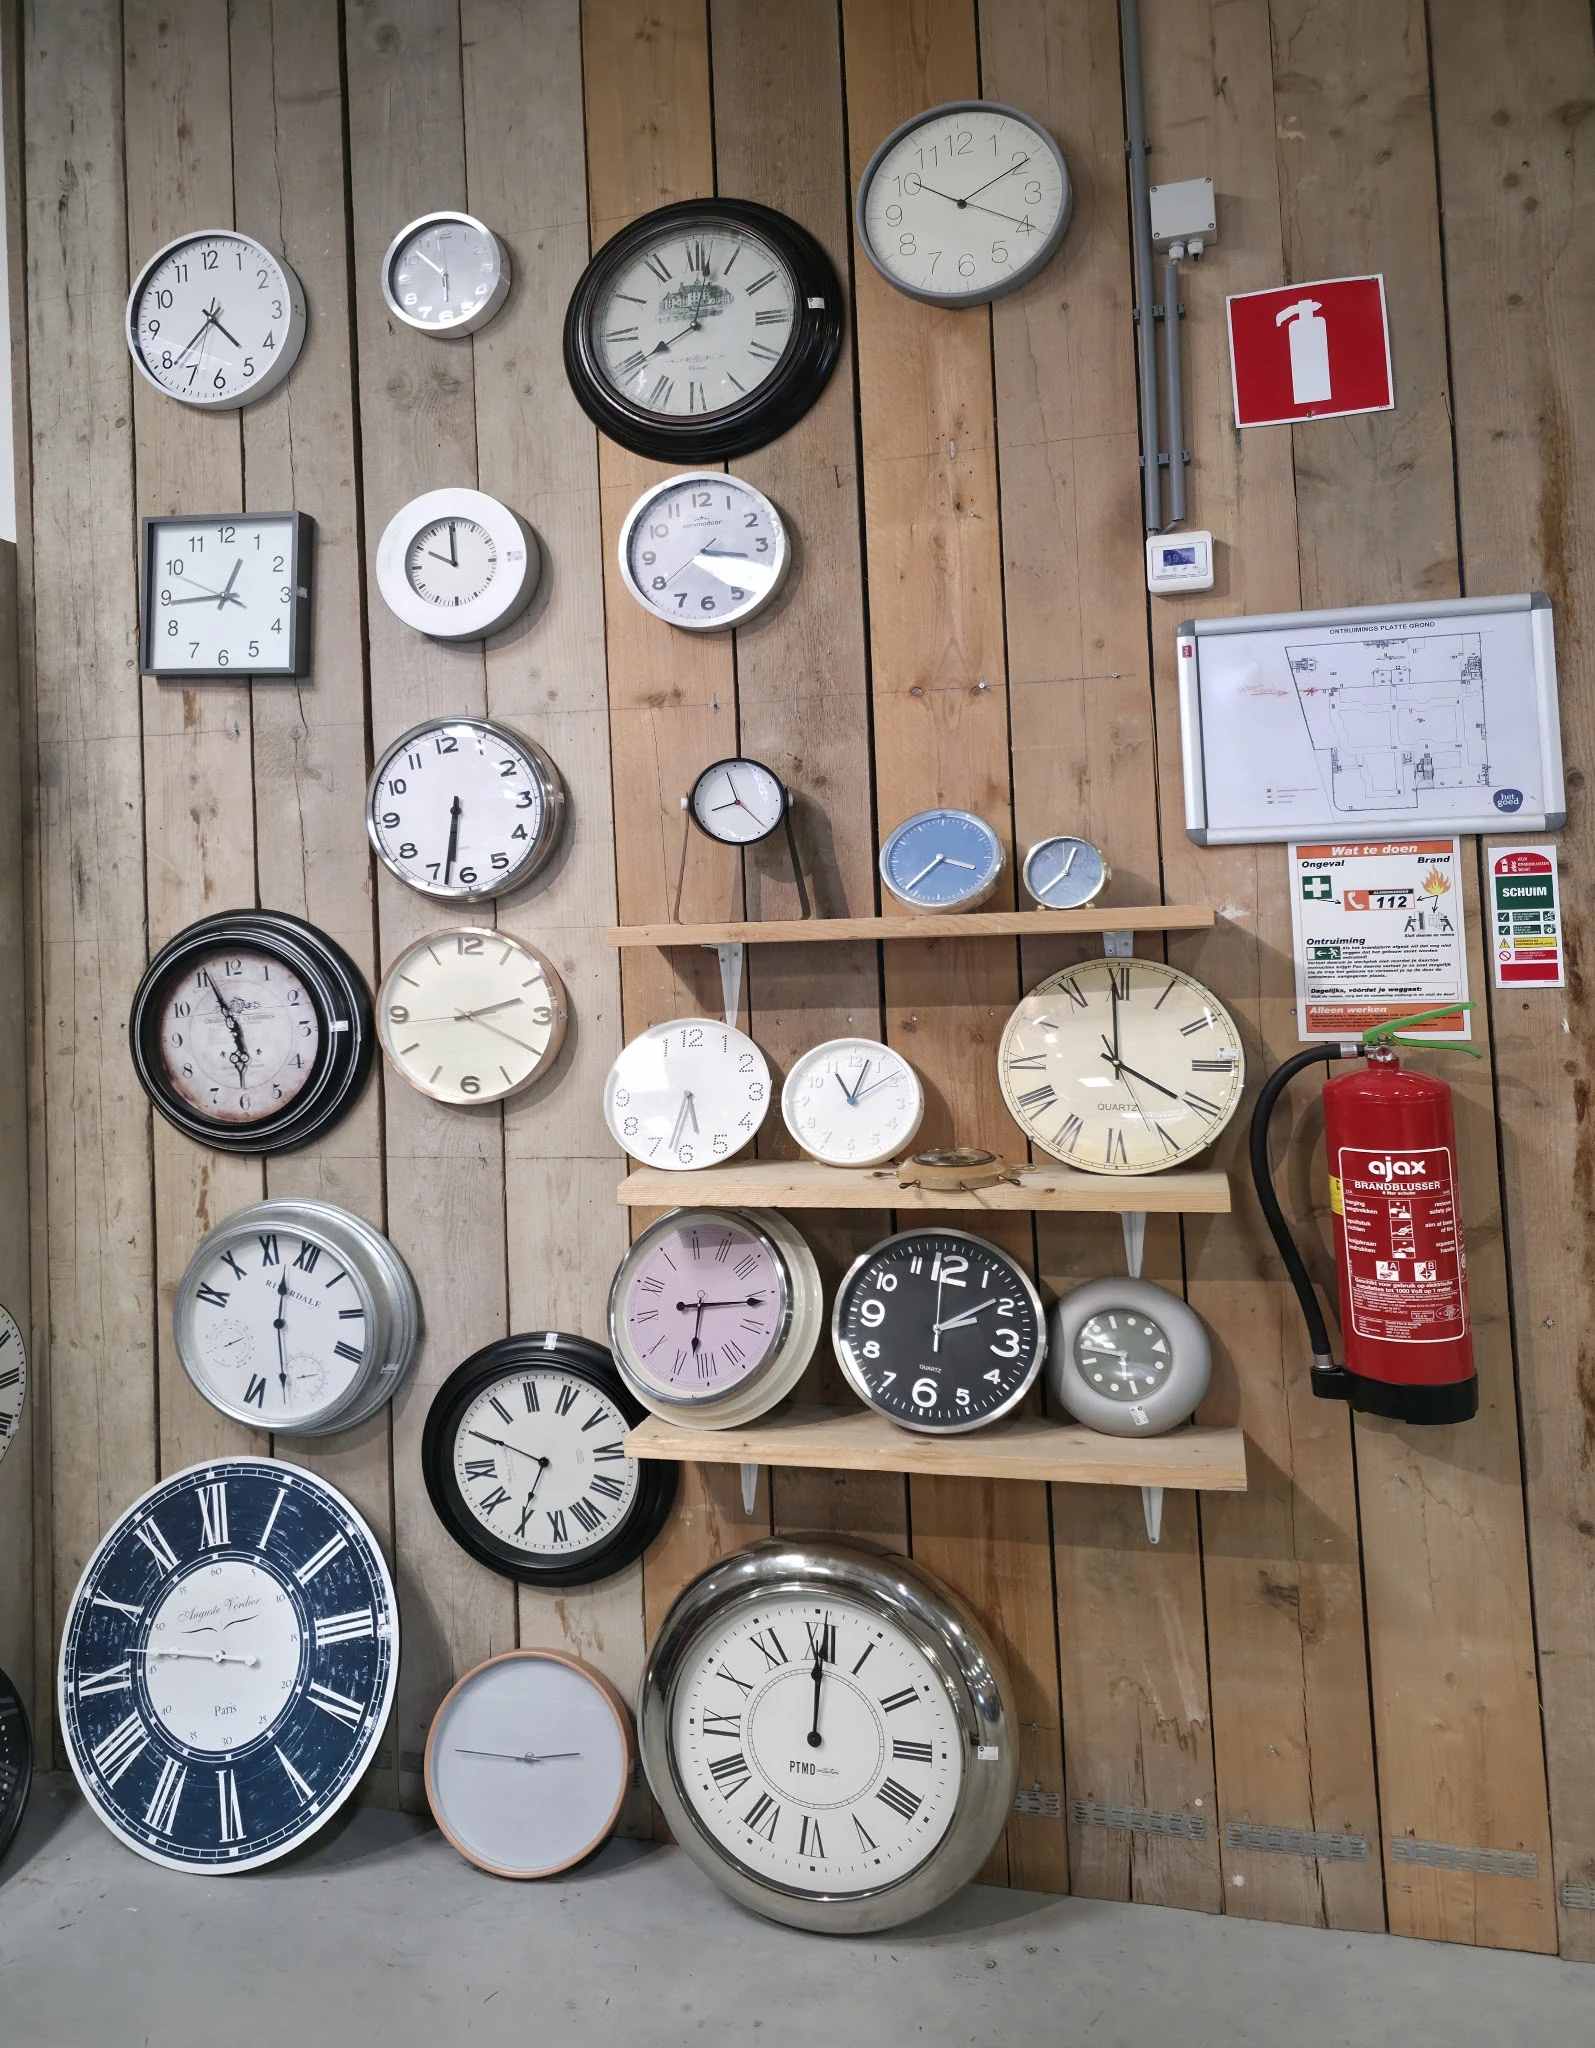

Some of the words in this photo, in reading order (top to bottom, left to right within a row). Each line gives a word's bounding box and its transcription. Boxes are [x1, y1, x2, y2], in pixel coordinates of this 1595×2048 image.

[944, 132, 973, 156] 12
[989, 135, 996, 156] 1
[915, 146, 938, 169] 11
[1012, 152, 1028, 175] 2
[893, 173, 921, 197] 10
[1025, 181, 1041, 204] 3
[886, 205, 902, 227] 9
[1016, 215, 1034, 236] 4
[900, 233, 916, 255] 8
[992, 241, 1008, 263] 5
[201, 251, 218, 270] 12
[236, 253, 242, 270] 1
[928, 251, 942, 274] 7
[959, 254, 975, 277] 6
[175, 264, 188, 283] 11
[257, 270, 269, 289] 2
[155, 290, 173, 309] 10
[272, 300, 282, 319] 3
[149, 320, 160, 340] 9
[263, 330, 275, 349] 4
[162, 351, 173, 369] 8
[243, 357, 254, 376] 5
[186, 364, 199, 386] 7
[214, 368, 225, 389] 6
[692, 493, 712, 508] 12
[727, 496, 731, 510] 1
[668, 503, 680, 518] 11
[744, 513, 758, 528] 2
[218, 527, 235, 543] 12
[650, 524, 669, 539] 10
[189, 536, 203, 552] 11
[254, 534, 260, 550] 1
[756, 537, 768, 552] 3
[273, 556, 283, 572] 2
[642, 552, 656, 565] 9
[166, 559, 183, 576] 10
[652, 576, 666, 590] 8
[161, 590, 171, 606] 9
[280, 587, 290, 603] 3
[674, 593, 687, 607] 7
[731, 587, 744, 600] 5
[701, 596, 715, 610] 6
[168, 620, 178, 636] 8
[271, 618, 282, 634] 4
[1330, 626, 1378, 634] ONTRUIMINGS
[189, 643, 199, 658] 7
[248, 641, 259, 657] 5
[218, 650, 229, 666] 6
[435, 737, 458, 754] 12
[409, 753, 422, 770] 11
[499, 760, 517, 777] 2
[389, 779, 406, 796] 10
[516, 791, 532, 808] 3
[1498, 798, 1519, 807] goed
[383, 813, 400, 828] 9
[511, 824, 528, 840] 4
[400, 843, 418, 859] 8
[1331, 847, 1358, 856] Wat
[1364, 846, 1377, 855] te
[1382, 845, 1417, 854] doen
[491, 852, 509, 869] 5
[1302, 860, 1345, 869] Ongeval
[1418, 856, 1450, 864] Brand
[426, 863, 441, 880] 7
[459, 867, 477, 883] 6
[1502, 887, 1547, 897] SCHUIM
[1376, 896, 1407, 908] 112
[458, 937, 484, 955] 12
[1307, 937, 1365, 945] Ontruiming
[389, 1005, 409, 1024] 9
[532, 1007, 551, 1025] 3
[460, 1076, 480, 1094] 6
[1097, 1103, 1138, 1111] QUARTZ
[1368, 1156, 1426, 1182] ajax
[1355, 1181, 1440, 1191] BRANDBLUSSER
[911, 1256, 922, 1274] 11
[931, 1252, 968, 1287] 12
[876, 1272, 897, 1292] 10
[982, 1271, 989, 1288] 1
[265, 1279, 322, 1309] RIRDALE
[860, 1300, 885, 1327] 9
[997, 1298, 1015, 1317] 2
[862, 1341, 880, 1358] 8
[990, 1329, 1020, 1357] 3
[919, 1364, 942, 1373] QUARTZ
[983, 1369, 1000, 1384] 4
[881, 1371, 897, 1387] 7
[912, 1378, 938, 1408] 6
[955, 1388, 970, 1405] 5
[211, 1568, 222, 1576] 60
[276, 1595, 285, 1603] 10
[178, 1607, 221, 1623] Auguste
[224, 1597, 261, 1611] Verdier
[281, 1680, 292, 1689] 20
[161, 1706, 171, 1716] 40
[214, 1703, 237, 1716] Paris
[258, 1716, 267, 1725] 25
[222, 1737, 232, 1747] 30
[790, 1761, 815, 1775] PTMD
